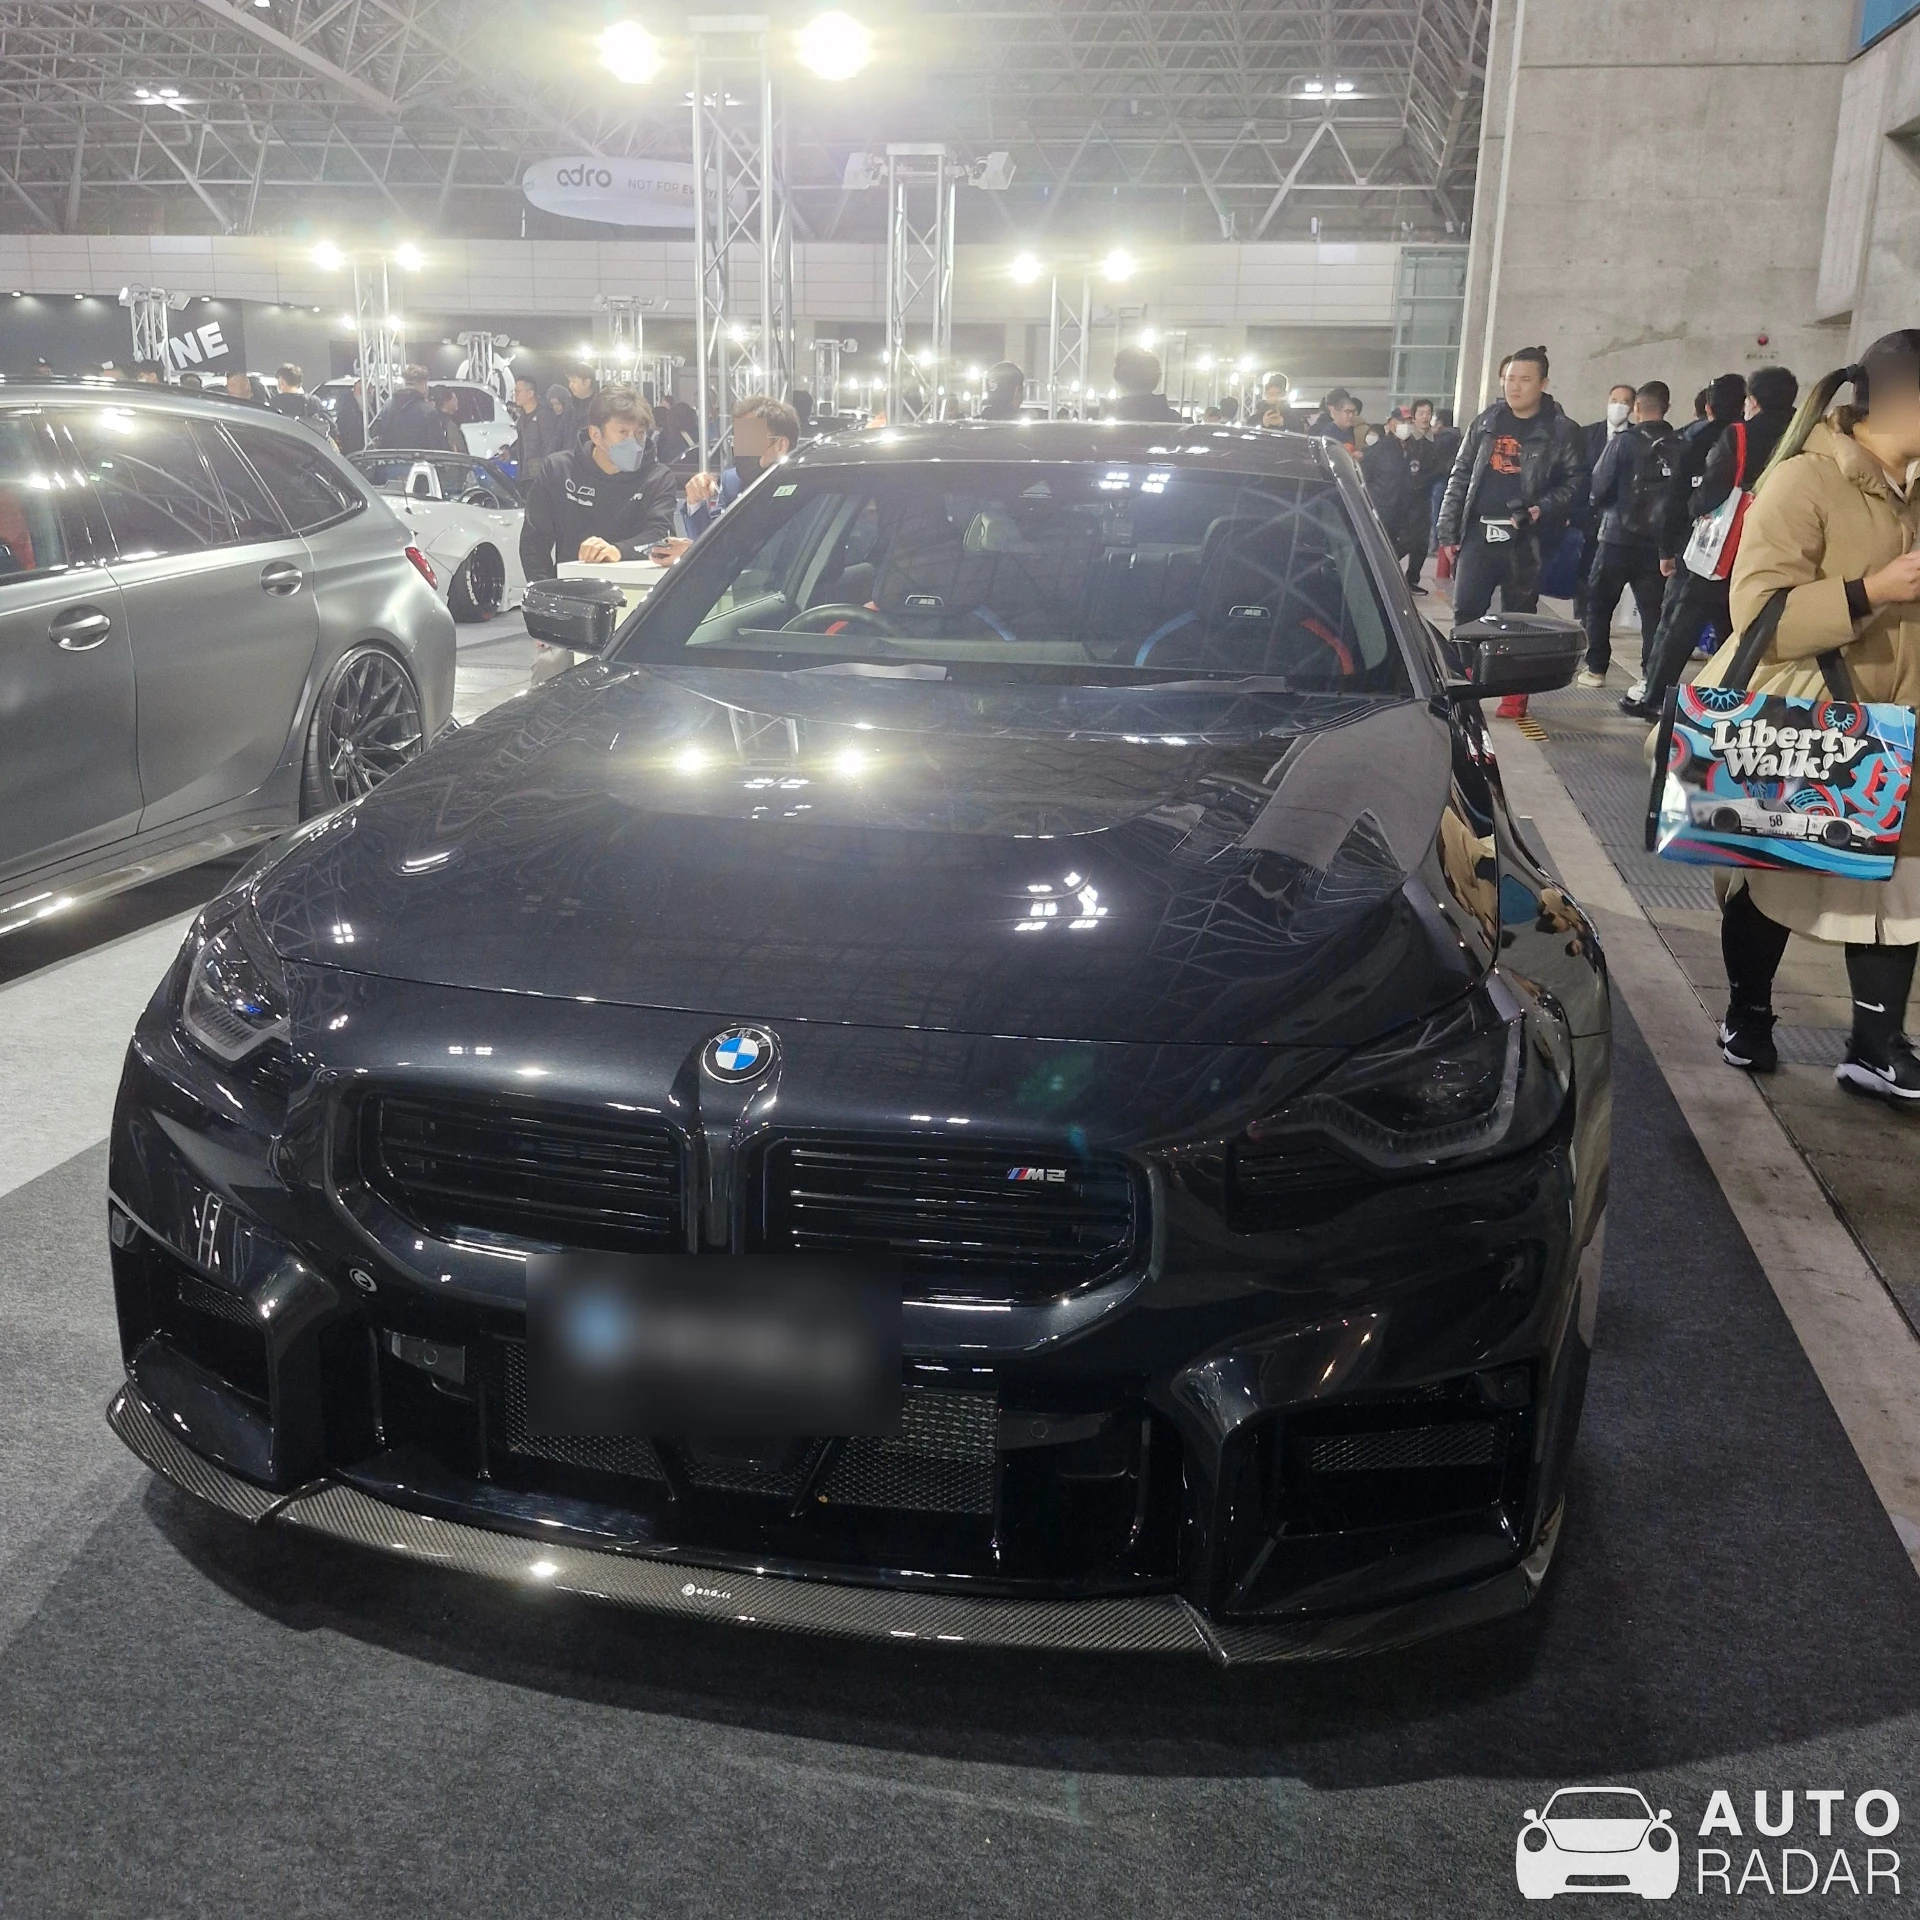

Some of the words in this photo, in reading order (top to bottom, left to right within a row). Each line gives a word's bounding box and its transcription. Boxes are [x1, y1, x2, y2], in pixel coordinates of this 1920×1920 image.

[556, 163, 613, 188] adro
[628, 178, 652, 190] NOT
[656, 181, 679, 193] FOR
[1711, 719, 1869, 763] Liberty
[1724, 747, 1835, 781] Walk!
[1769, 814, 1784, 828] 58
[715, 1028, 770, 1048] BMW
